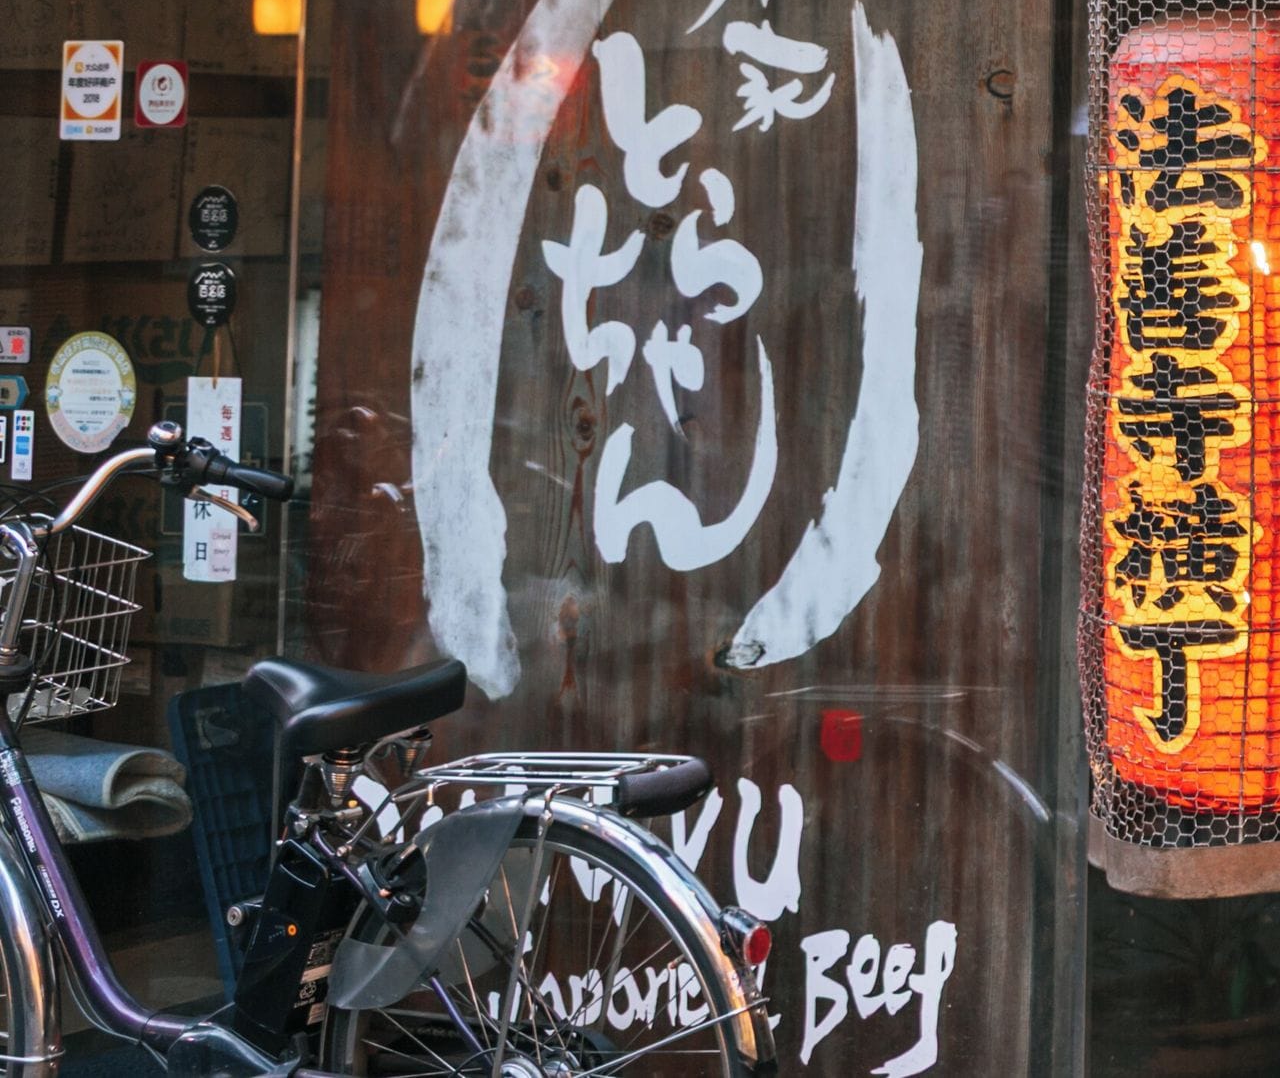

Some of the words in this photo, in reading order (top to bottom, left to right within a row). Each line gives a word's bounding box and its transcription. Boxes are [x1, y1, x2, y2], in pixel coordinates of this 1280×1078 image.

[542, 31, 779, 572] とらちゃん
[1115, 82, 1249, 745] 法善寺横丁
[800, 921, 958, 1078] Beef
